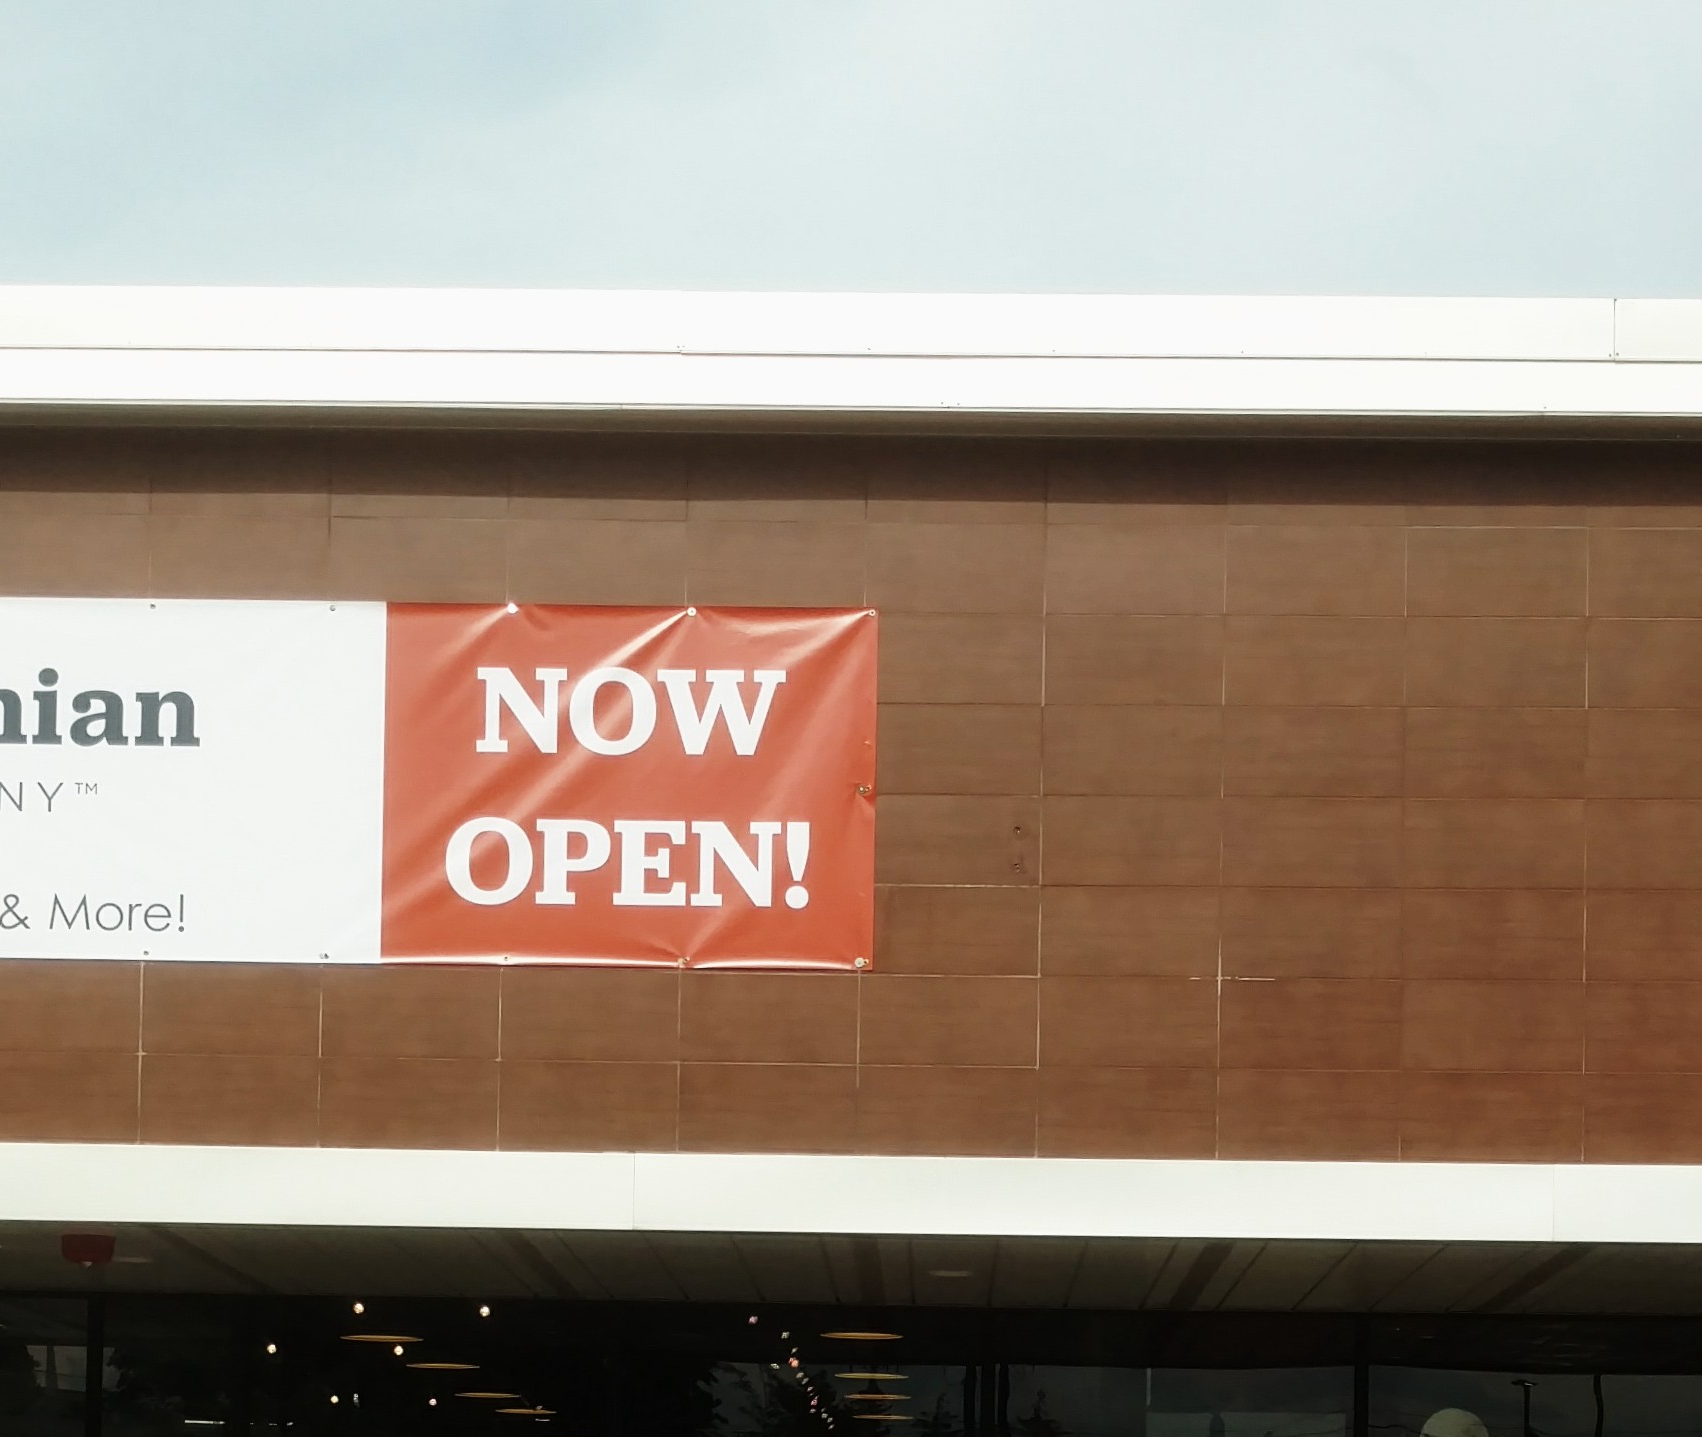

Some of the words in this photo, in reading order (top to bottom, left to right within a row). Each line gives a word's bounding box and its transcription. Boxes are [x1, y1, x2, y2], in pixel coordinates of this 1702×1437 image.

[476, 666, 787, 756] NOW
[445, 817, 810, 909] OPEN!
[49, 893, 187, 933] More!
